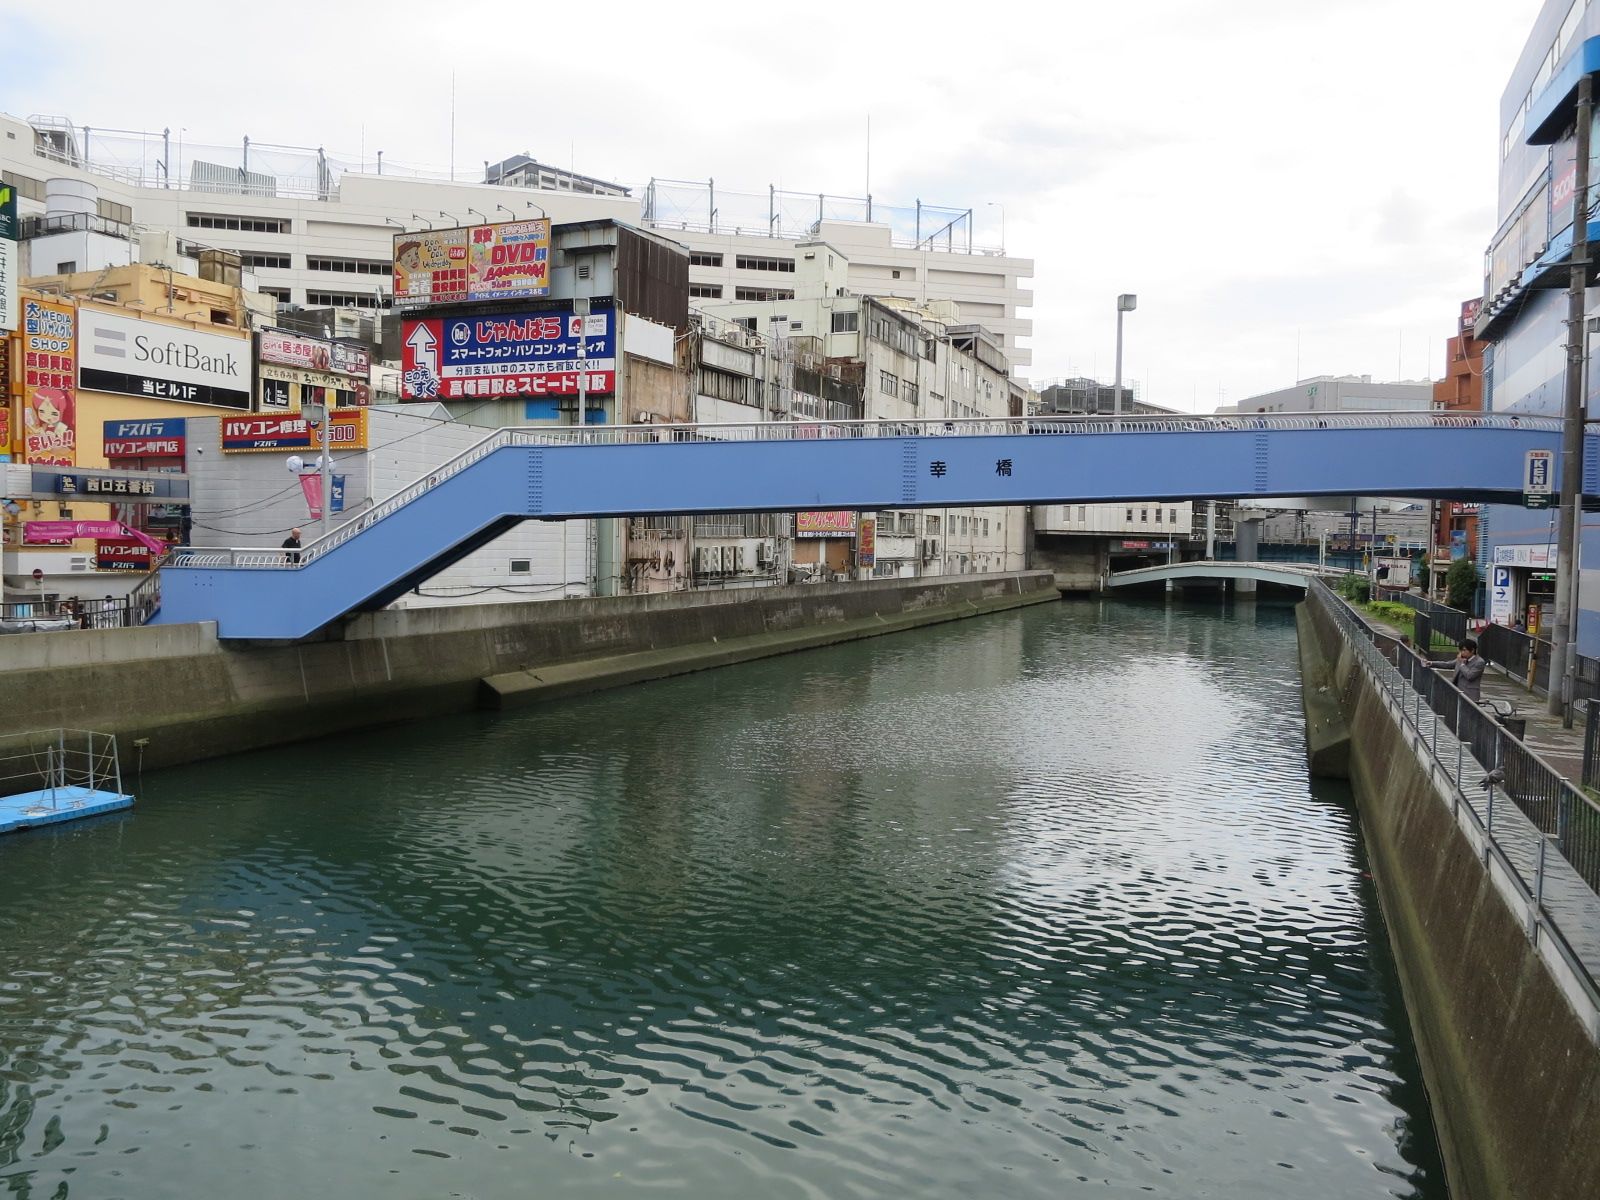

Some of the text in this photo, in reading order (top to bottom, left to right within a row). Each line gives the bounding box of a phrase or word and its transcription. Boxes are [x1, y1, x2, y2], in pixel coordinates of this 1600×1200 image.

[41, 311, 73, 323] MEDIA
[31, 337, 70, 352] SHOP
[135, 335, 239, 377] SoftBank
[1532, 459, 1545, 485] KEN
[87, 478, 155, 494] 西口五番街
